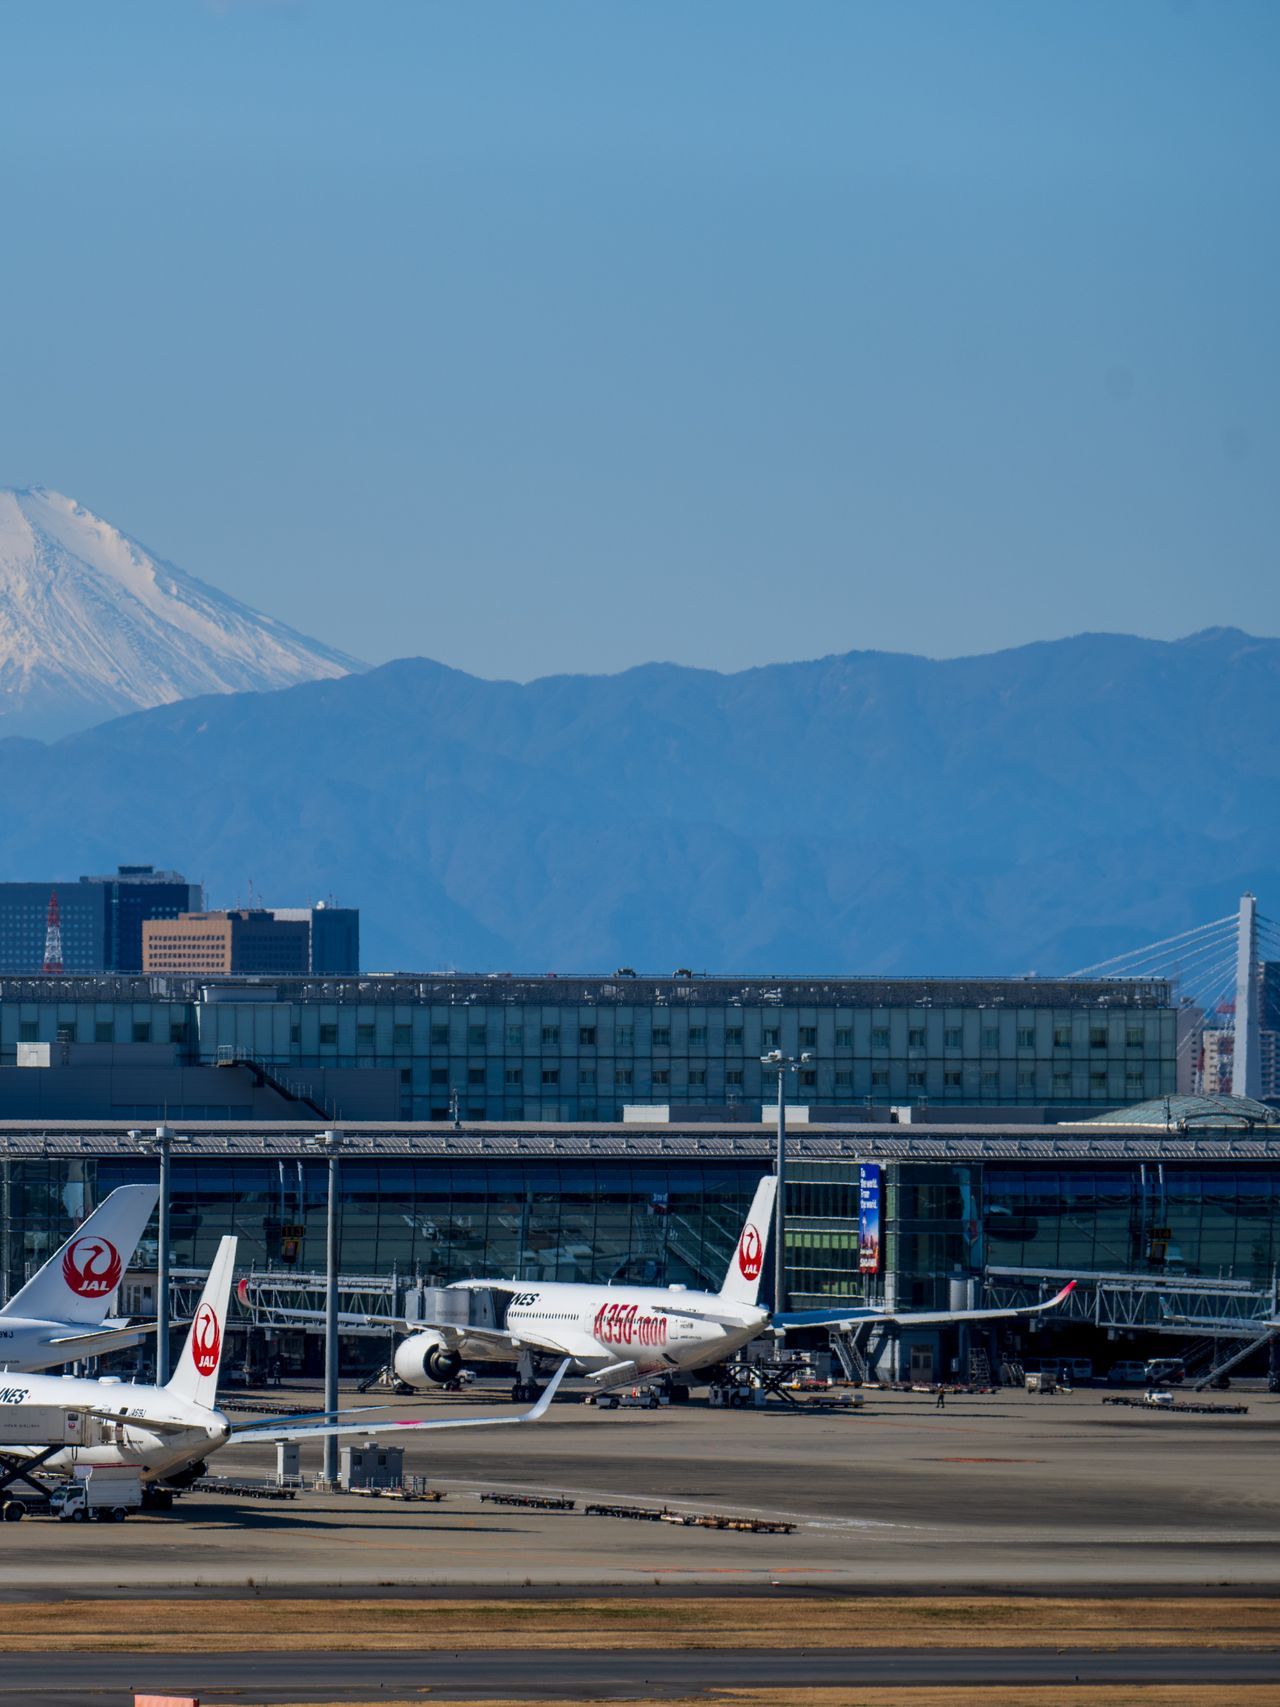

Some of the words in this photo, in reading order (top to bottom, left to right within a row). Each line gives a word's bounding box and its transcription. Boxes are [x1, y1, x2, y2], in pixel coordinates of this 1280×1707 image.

[744, 1263, 758, 1274] JAL
[78, 1280, 111, 1291] JAL
[510, 1292, 540, 1306] NES
[594, 1303, 668, 1346] A350-1000
[198, 1355, 216, 1368] JAL
